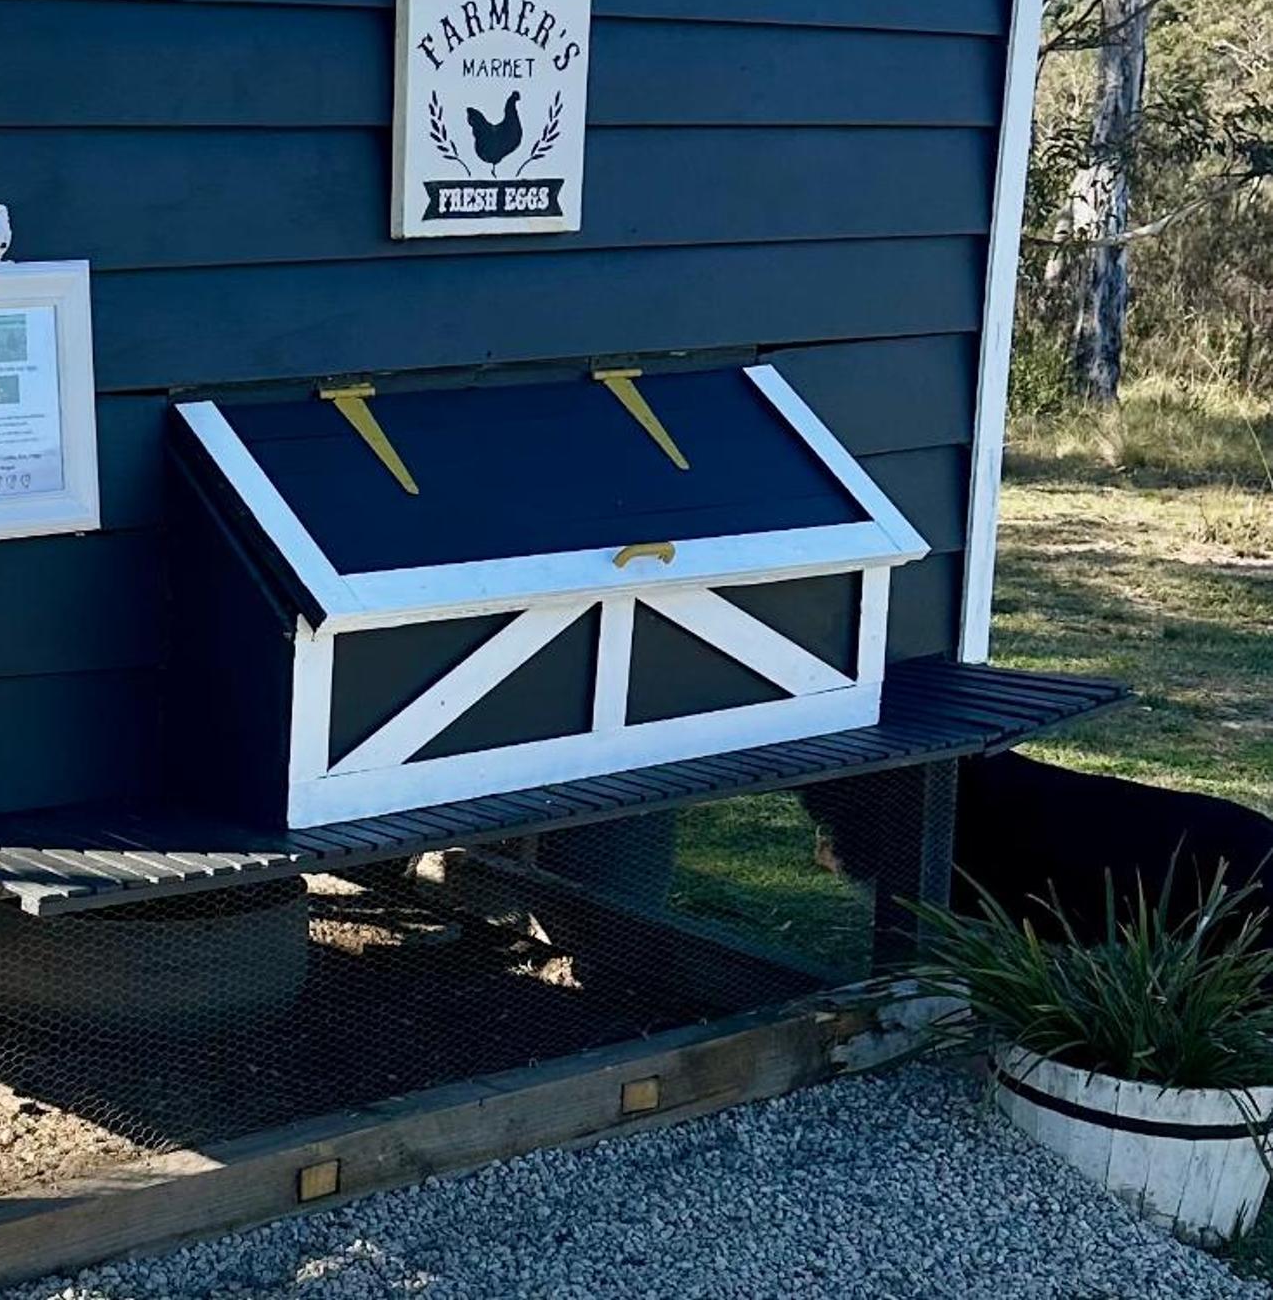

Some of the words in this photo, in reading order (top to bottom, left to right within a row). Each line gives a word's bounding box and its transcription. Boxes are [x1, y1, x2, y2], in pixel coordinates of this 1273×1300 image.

[463, 58, 535, 78] MARKET
[438, 188, 497, 213] FRESH
[504, 186, 549, 210] EGGS
